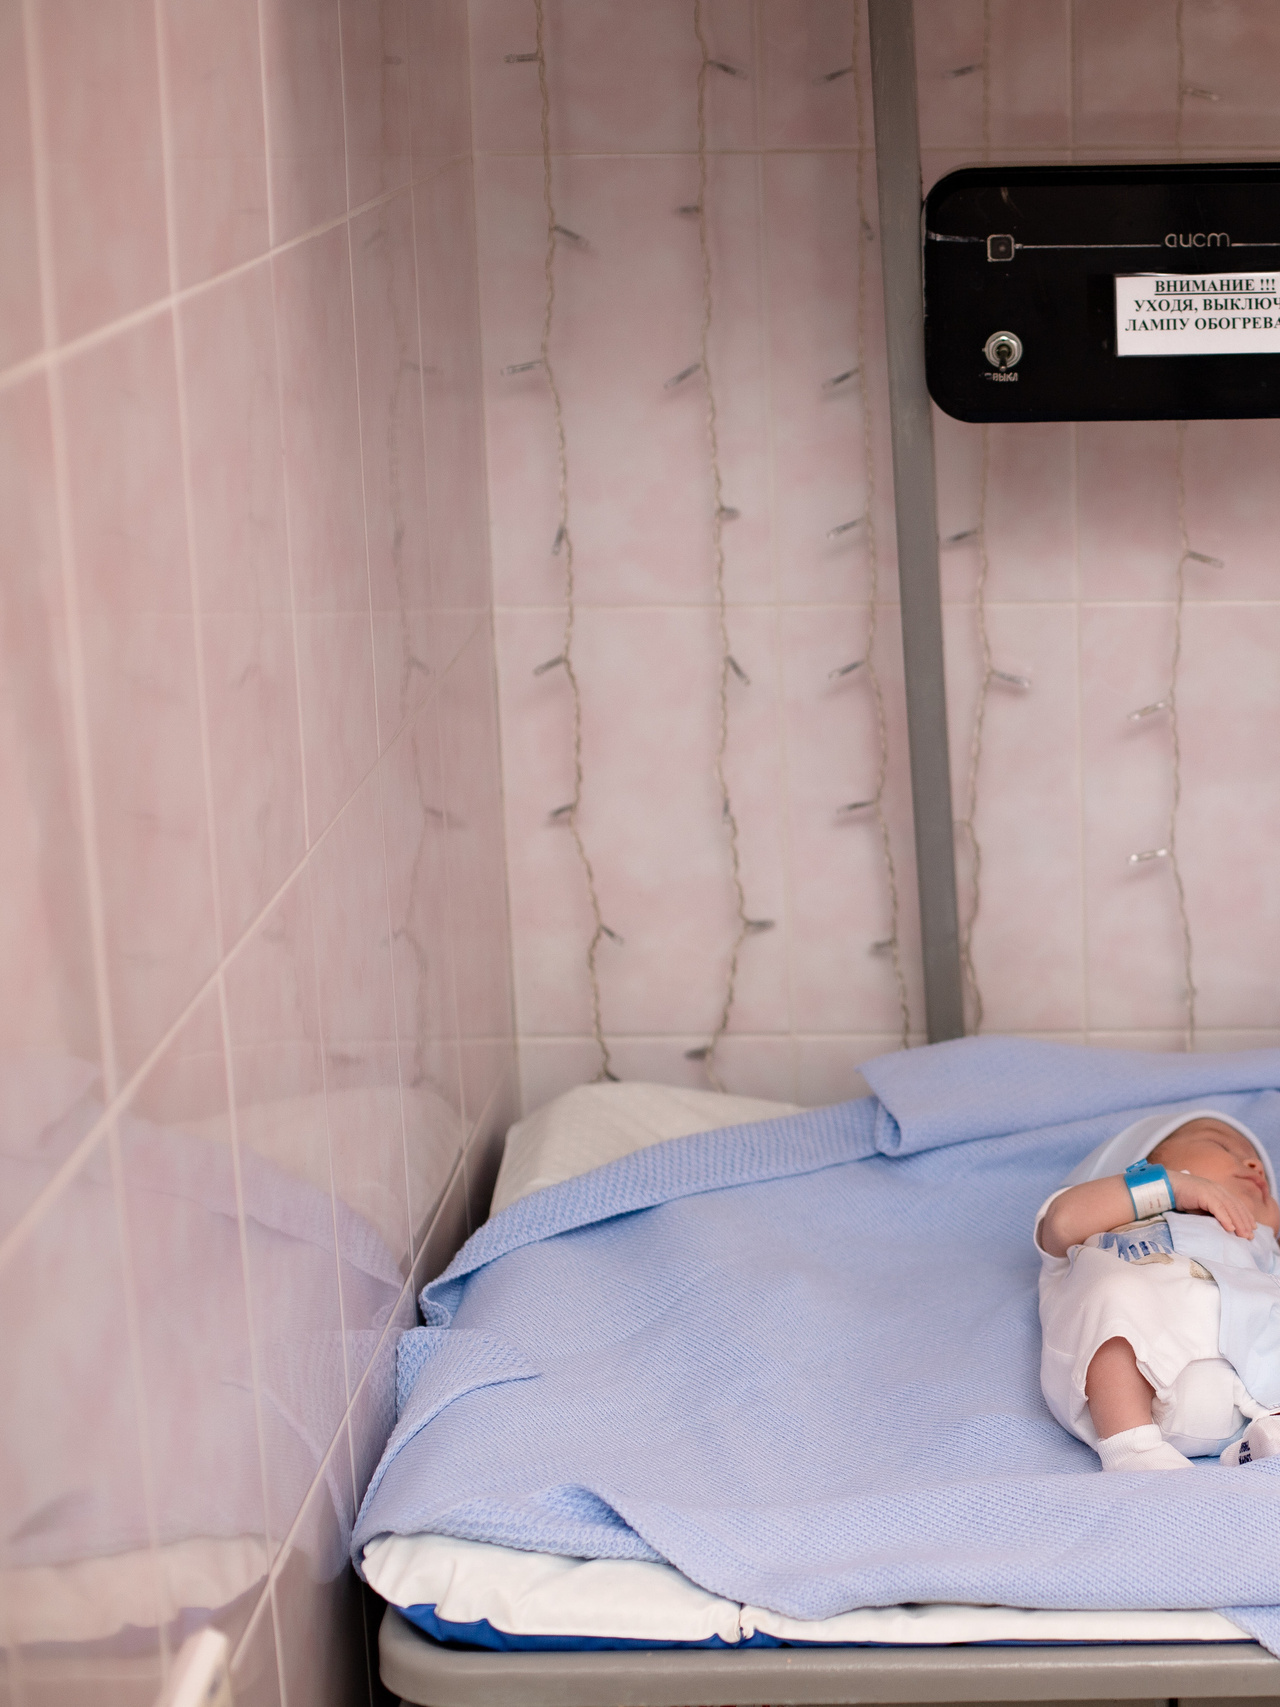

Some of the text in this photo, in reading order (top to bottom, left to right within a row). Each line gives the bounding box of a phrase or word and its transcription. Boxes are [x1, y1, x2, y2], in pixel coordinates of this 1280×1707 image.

[1154, 278, 1276, 293] ВНИМАНИЕ !!!
[1134, 299, 1198, 313] УХОДЯ,
[1125, 318, 1190, 332] ЛАМПУ
